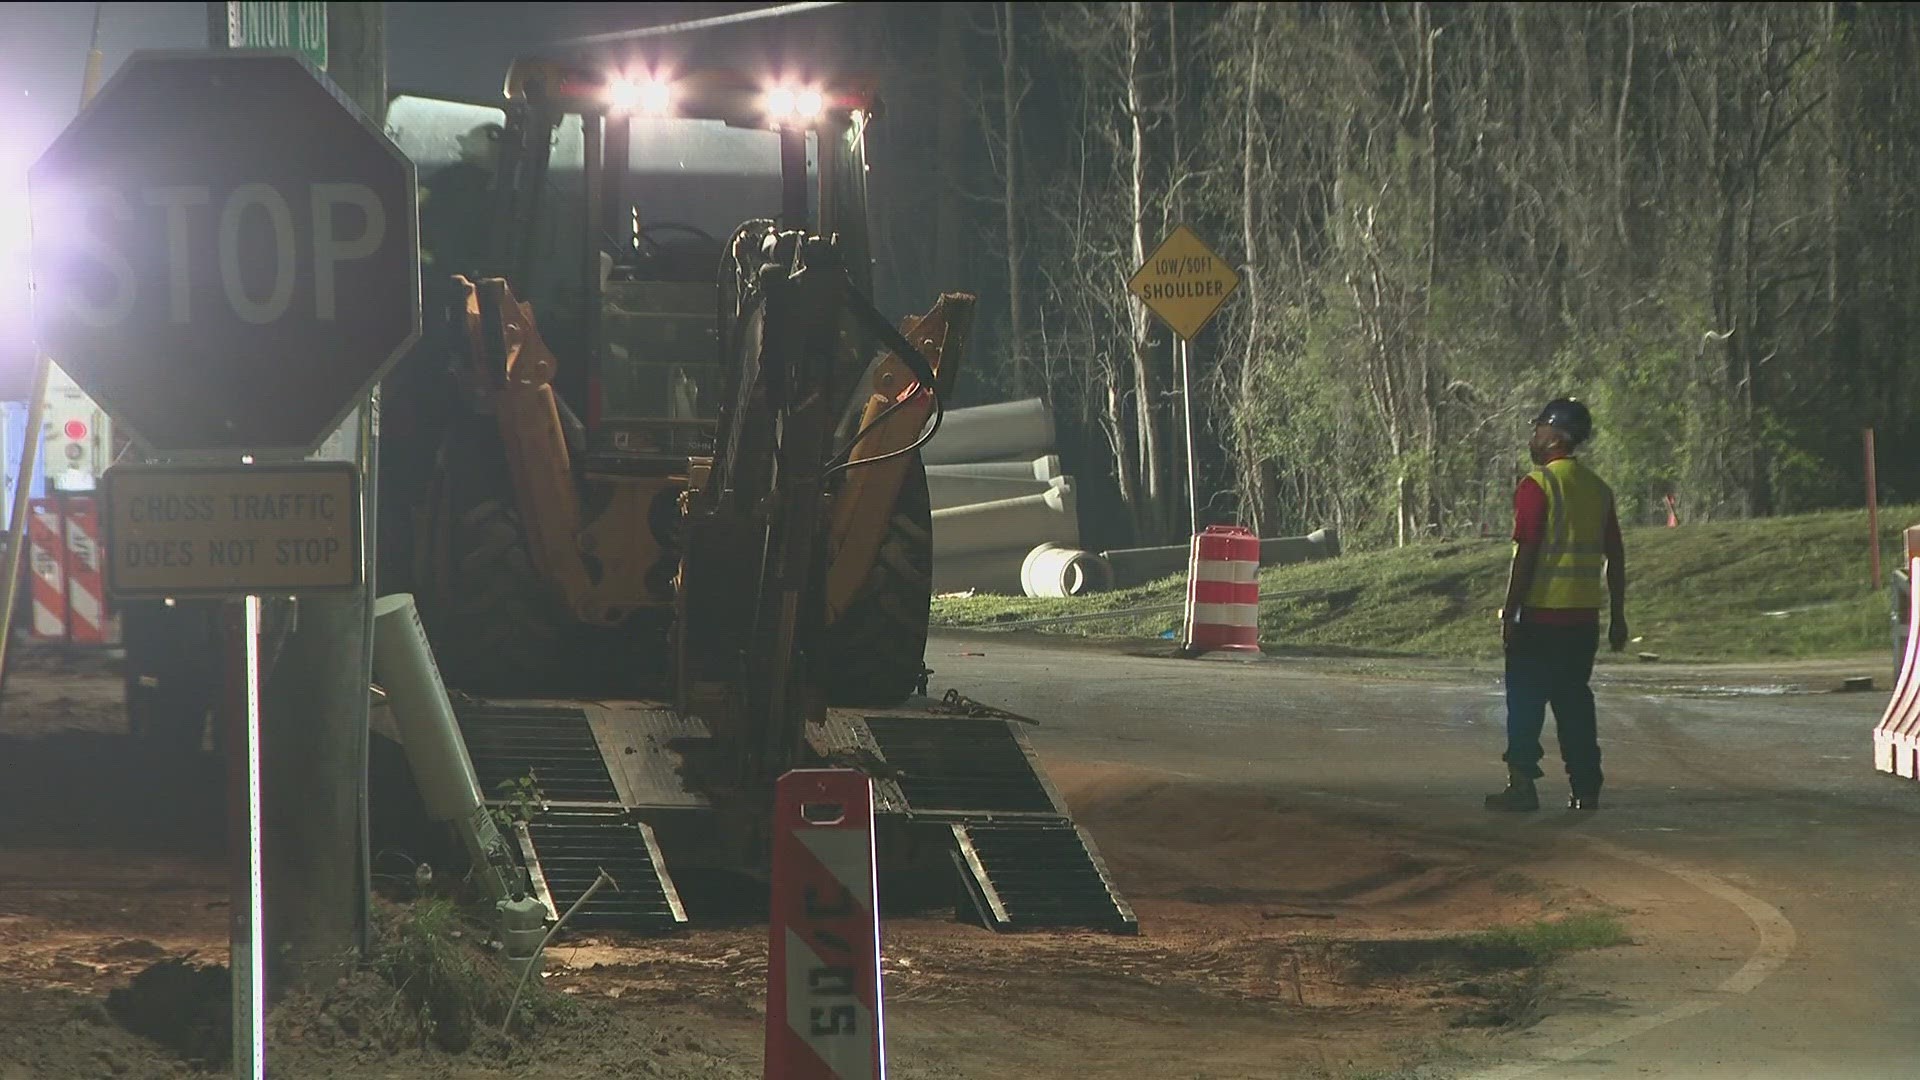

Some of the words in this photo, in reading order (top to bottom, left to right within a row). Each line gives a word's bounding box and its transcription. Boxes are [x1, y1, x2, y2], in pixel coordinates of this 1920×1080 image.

[64, 182, 387, 326] STOP
[1155, 255, 1212, 278] LOW/SOFT
[1143, 280, 1223, 299] SHOULDER
[130, 495, 215, 522] CROSS
[230, 493, 335, 520] TRAFFIC
[126, 540, 192, 567] DOES
[209, 538, 256, 566] NOT
[276, 536, 339, 565] STOP
